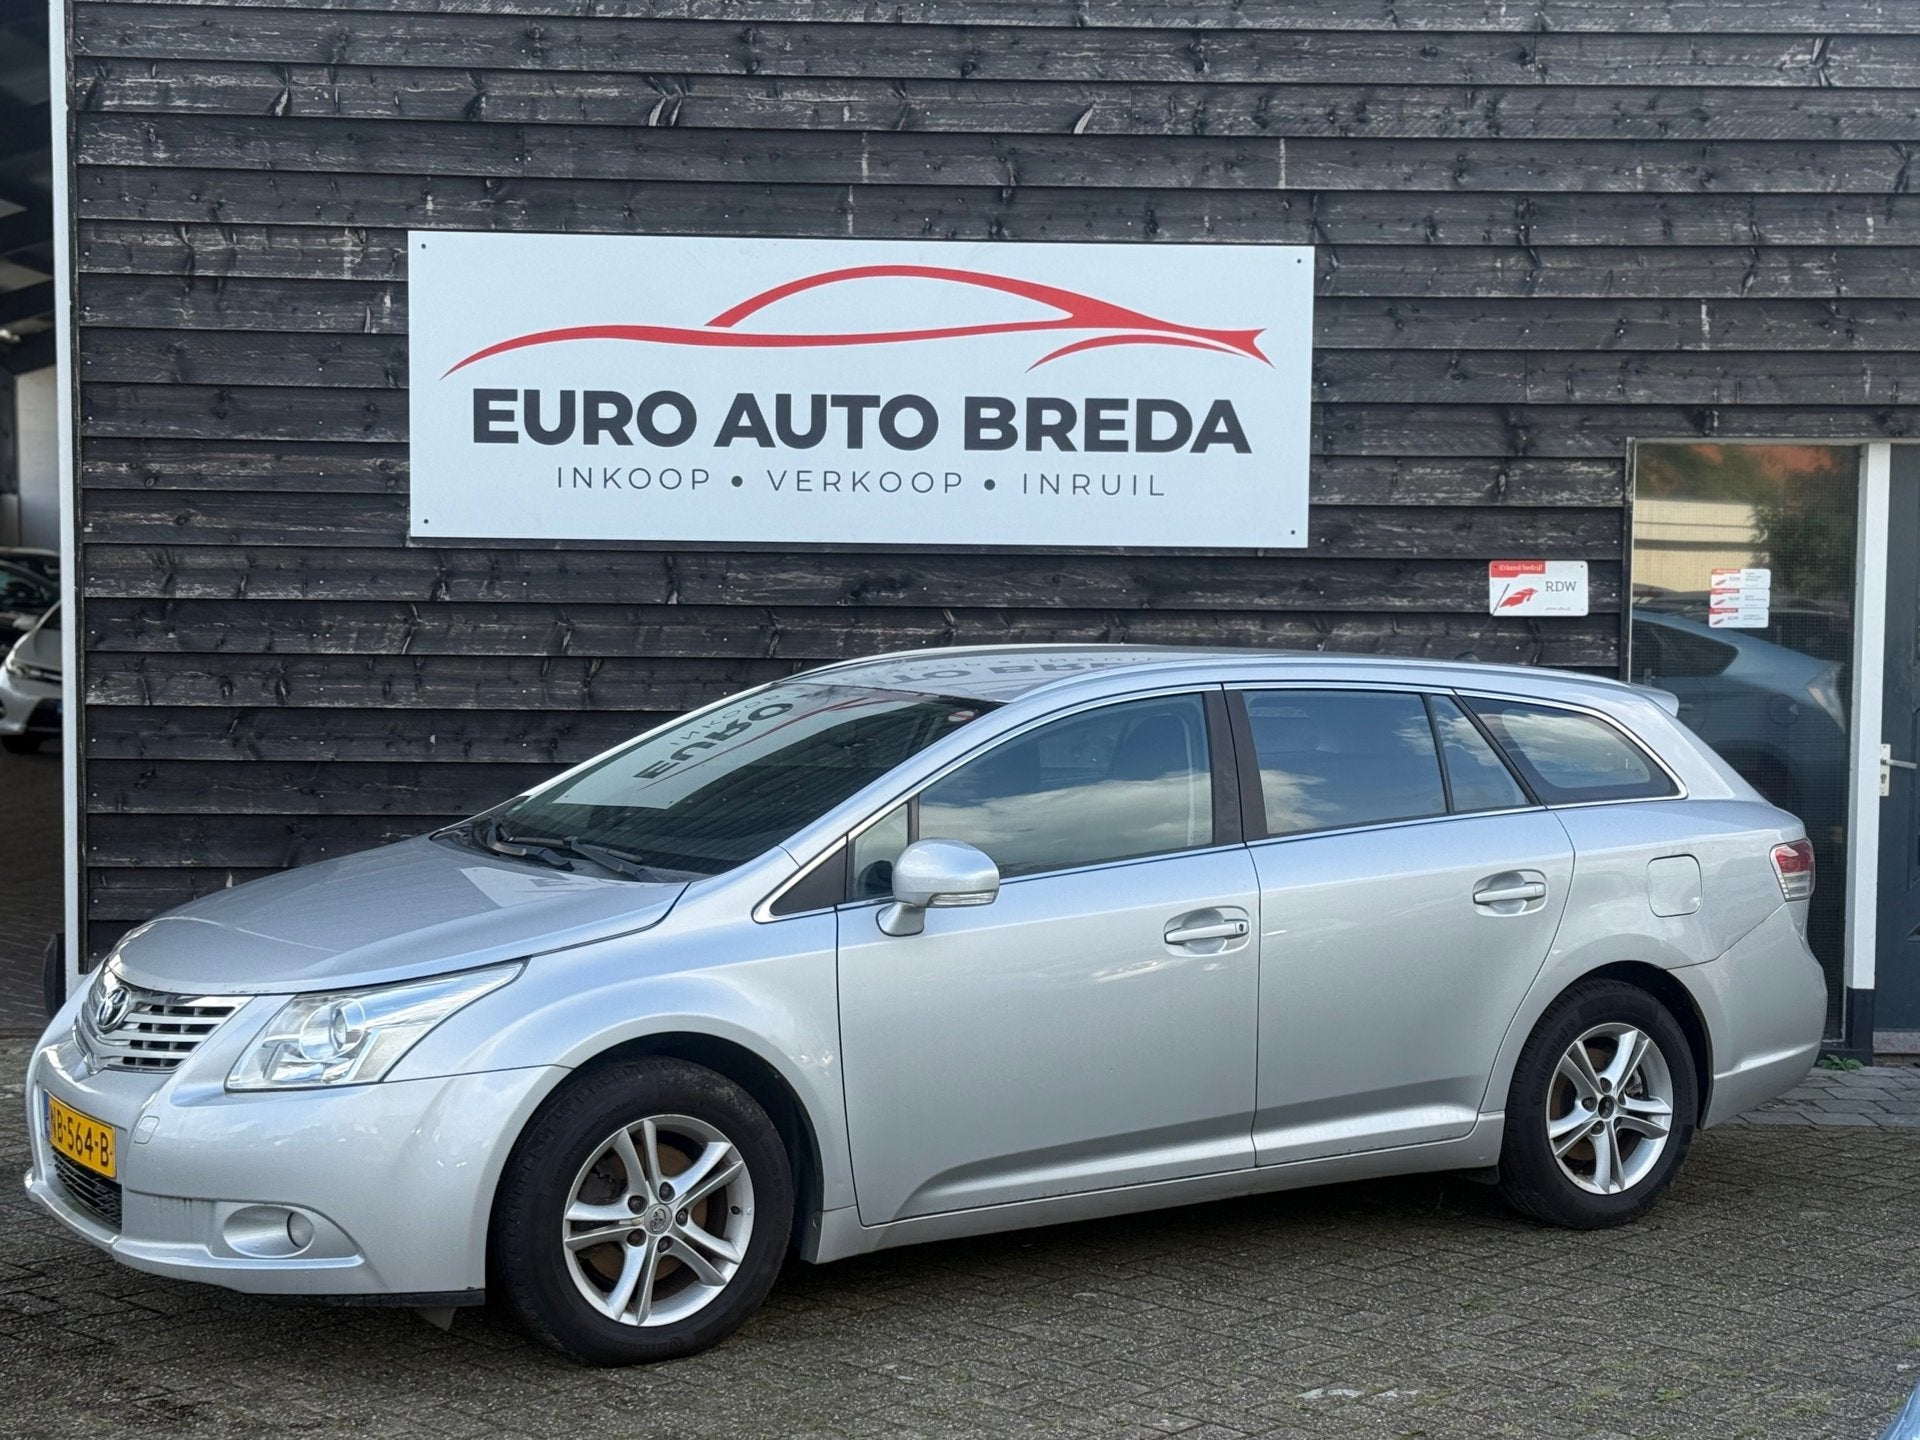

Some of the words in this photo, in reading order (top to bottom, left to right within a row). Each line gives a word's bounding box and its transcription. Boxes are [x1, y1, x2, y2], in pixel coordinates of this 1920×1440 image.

[473, 388, 698, 448] EURO
[713, 392, 939, 451] AUTO
[964, 396, 1252, 454] BREDA
[558, 467, 709, 491] INKOOP
[766, 469, 962, 495] VERKOOP
[1023, 473, 1164, 496] INRUIL
[1545, 581, 1577, 592] RDW
[51, 1106, 109, 1167] NB-564-B
